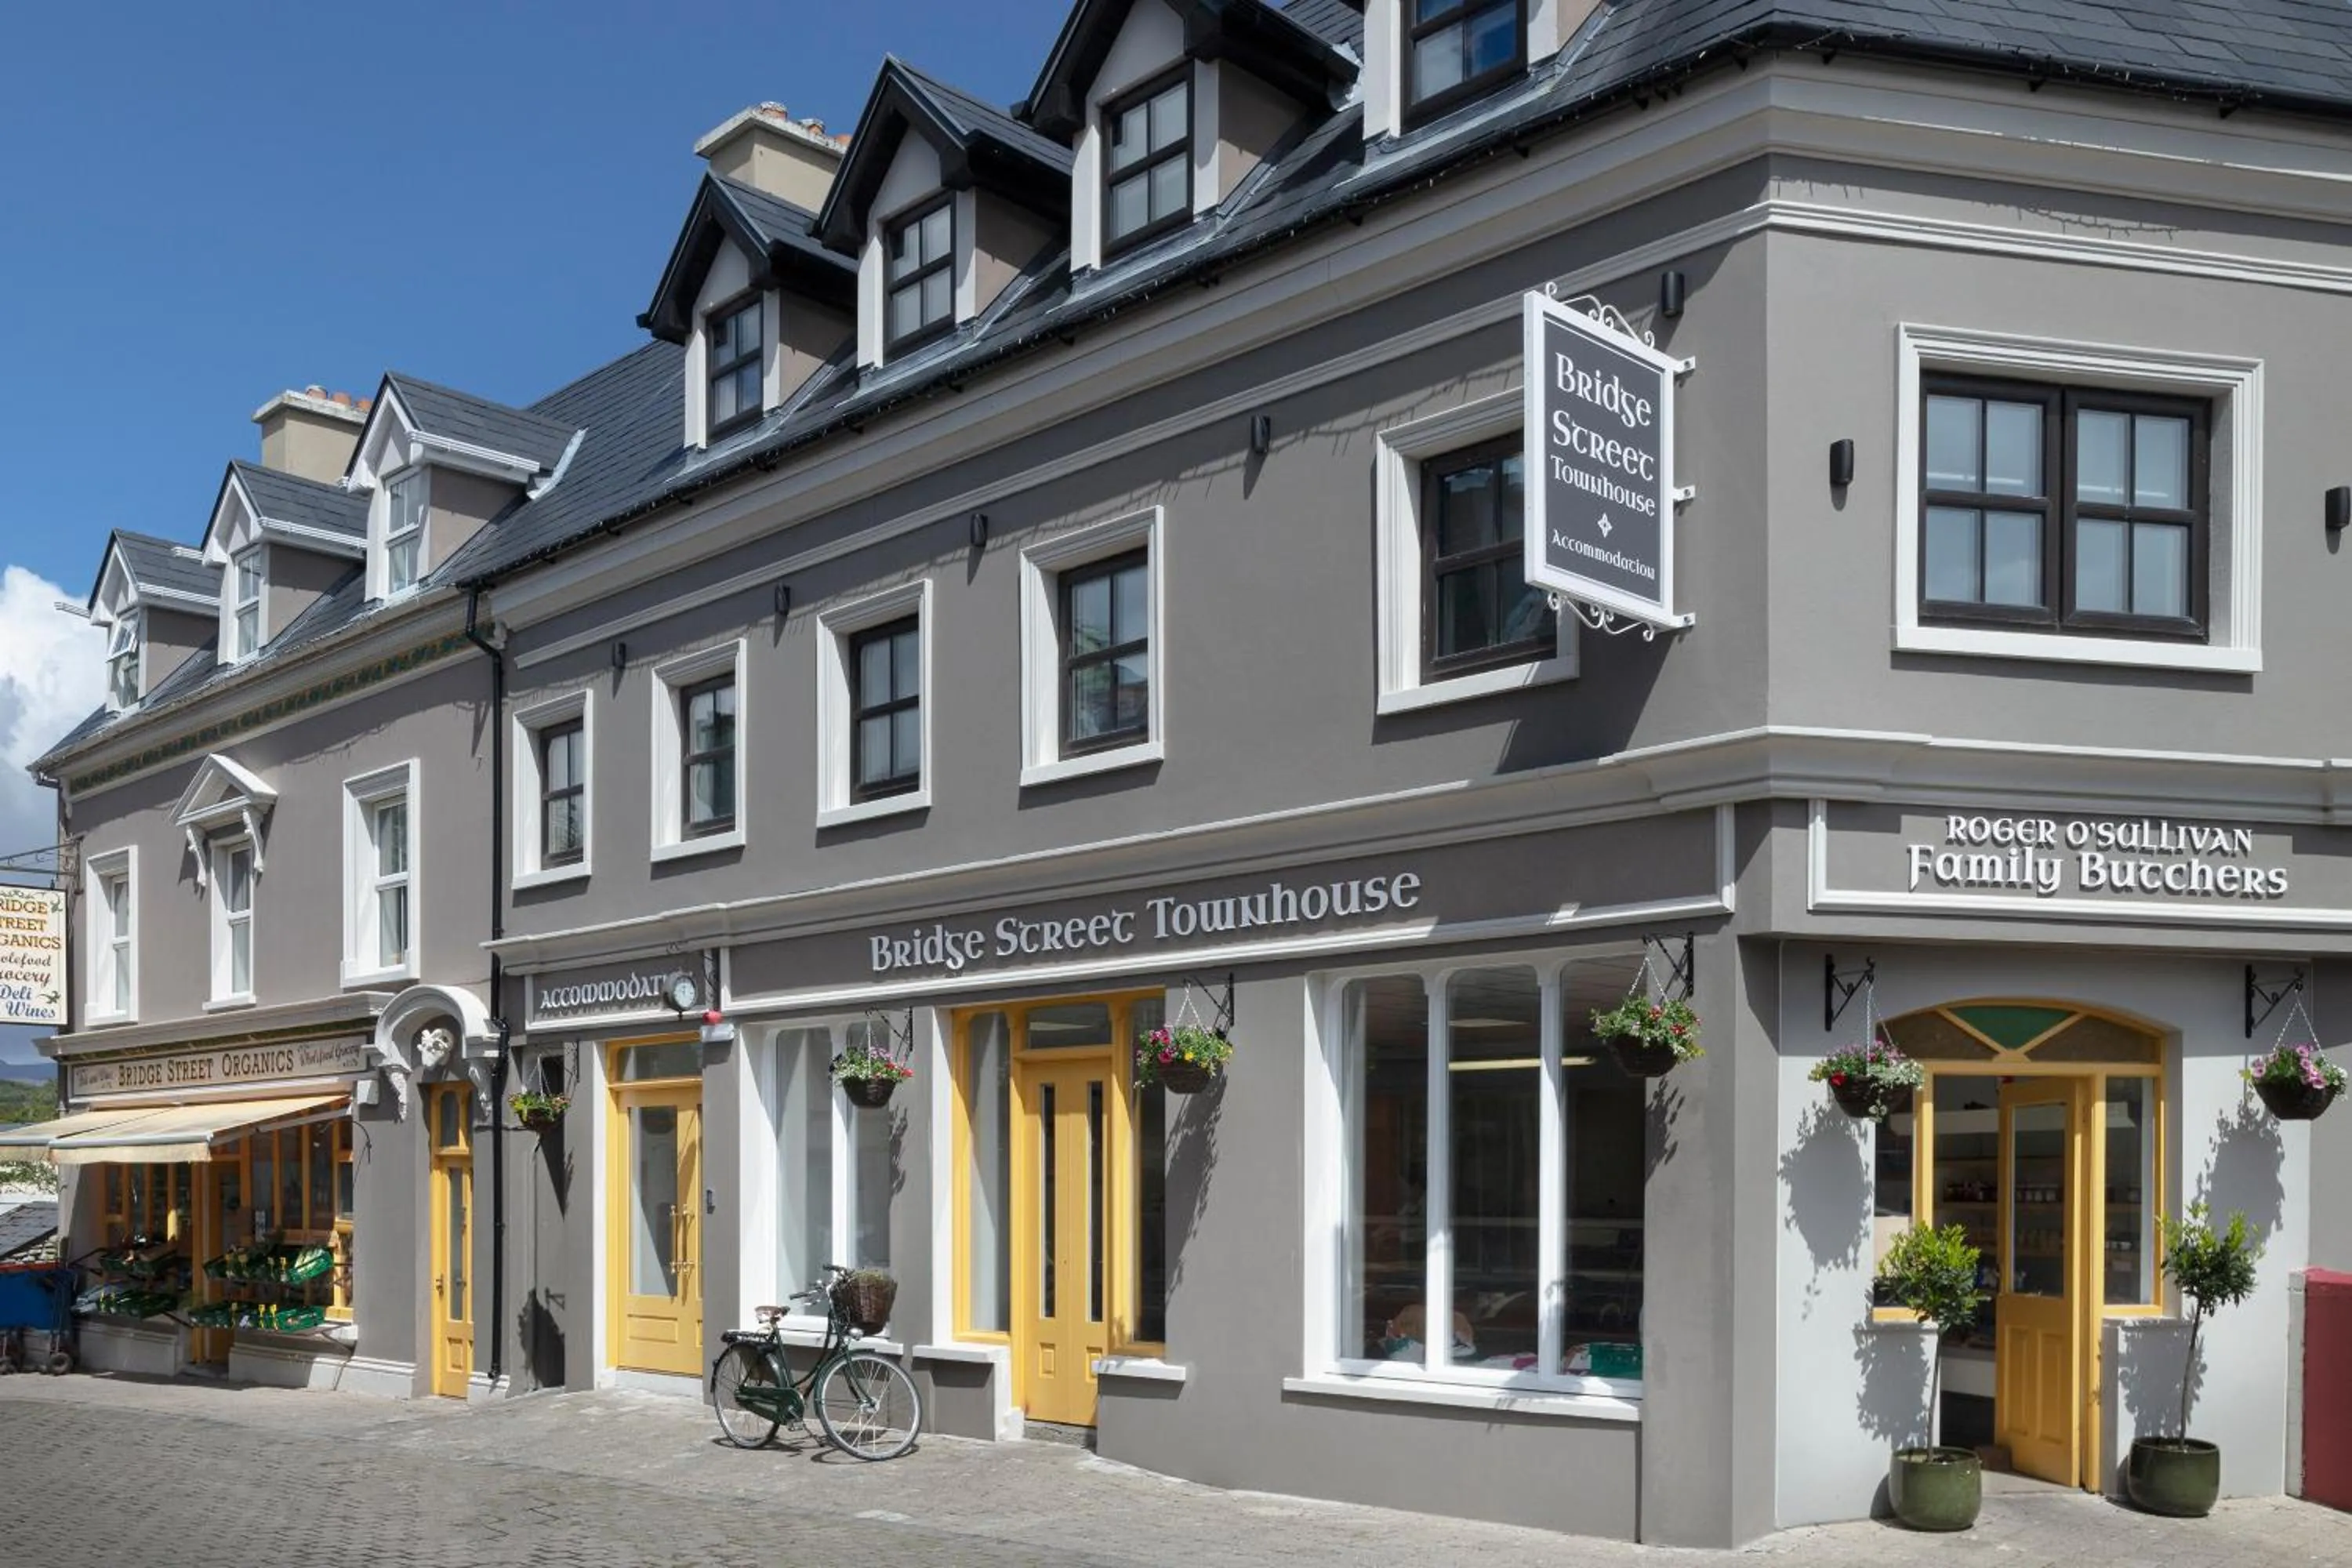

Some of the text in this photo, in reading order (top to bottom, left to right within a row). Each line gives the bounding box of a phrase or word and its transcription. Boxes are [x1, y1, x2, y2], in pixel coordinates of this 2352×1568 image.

[1555, 352, 1653, 428] Bridge
[1552, 409, 1654, 482] Street
[1550, 454, 1656, 517] Townhouse
[1552, 528, 1655, 580] Accommodation
[1946, 815, 2253, 855] ROGER O'SULLIVAN
[1907, 844, 2288, 895] Family Butchers
[869, 870, 1421, 971] Bridge Street Townhouse
[6, 1001, 56, 1018] Wines
[539, 971, 668, 1009] ACCOMMODAT
[118, 1063, 163, 1087] BRIDGE
[167, 1058, 213, 1083] STREET
[222, 1049, 295, 1077] ORGANICS
